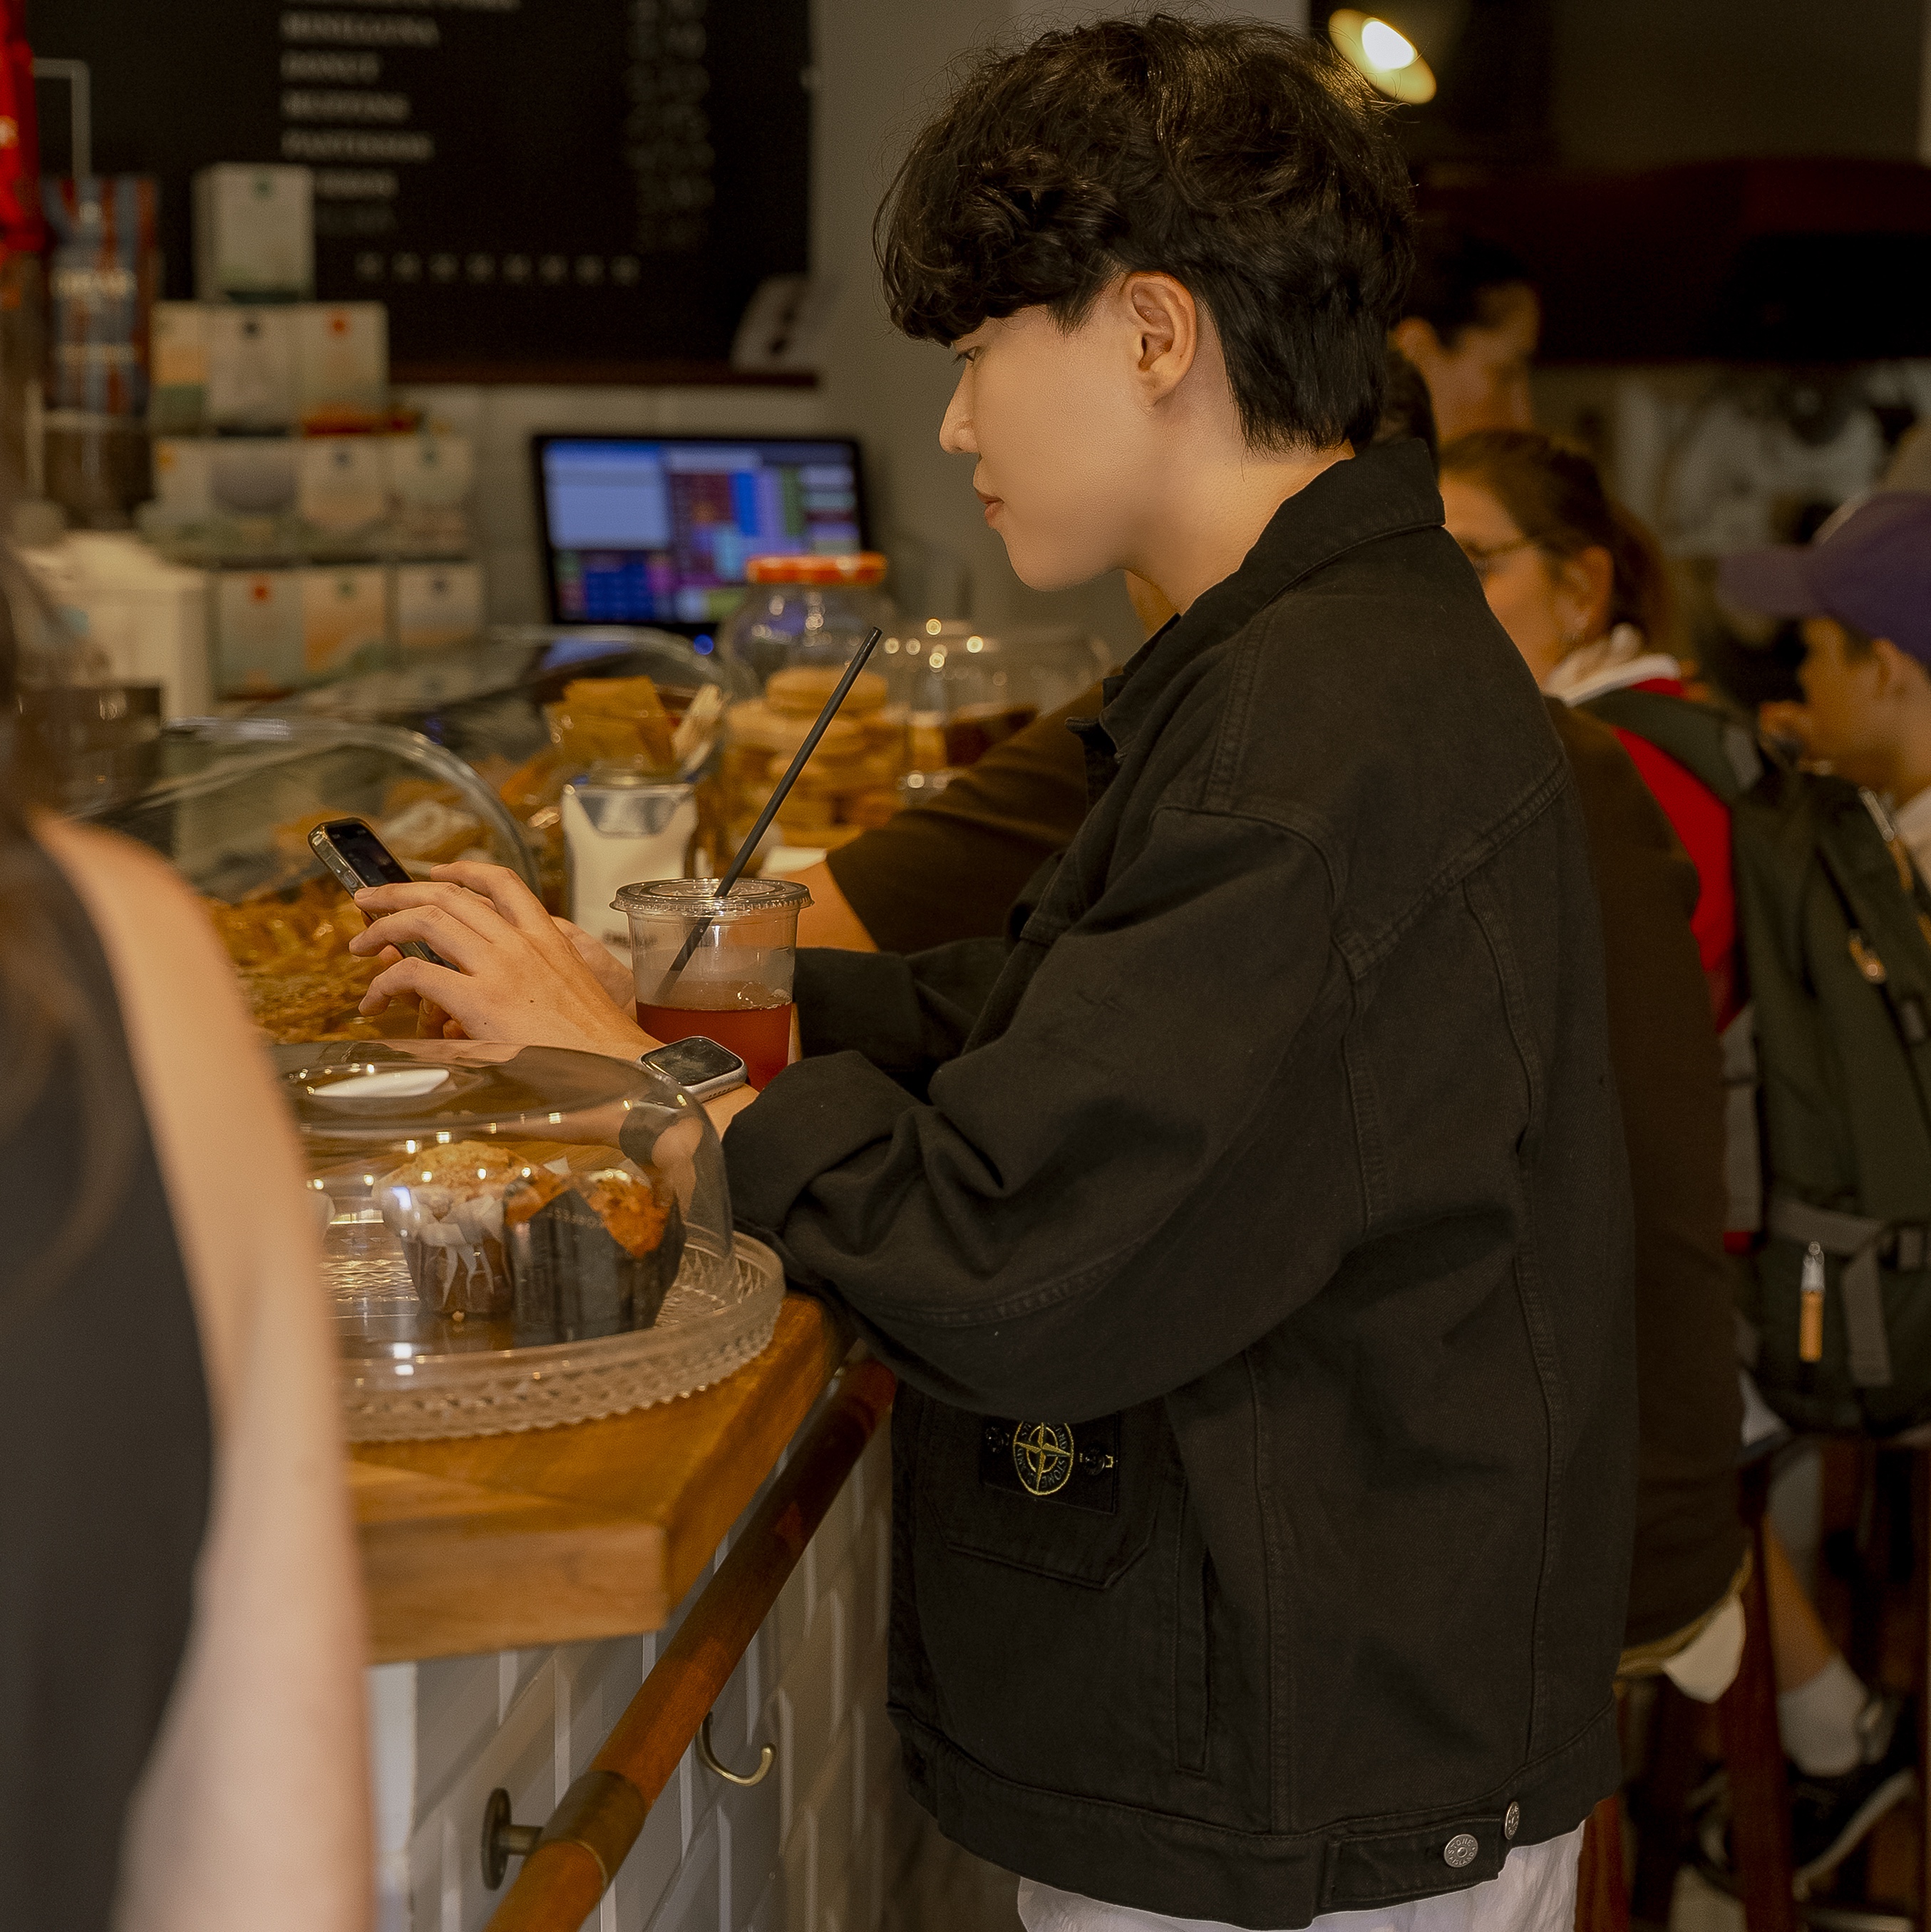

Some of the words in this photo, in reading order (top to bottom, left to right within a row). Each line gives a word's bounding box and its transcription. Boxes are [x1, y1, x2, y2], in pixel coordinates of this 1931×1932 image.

[1041, 1460, 1068, 1489] STONE
[1447, 1838, 1474, 1854] STONE
[1451, 1851, 1475, 1866] ISLAND
